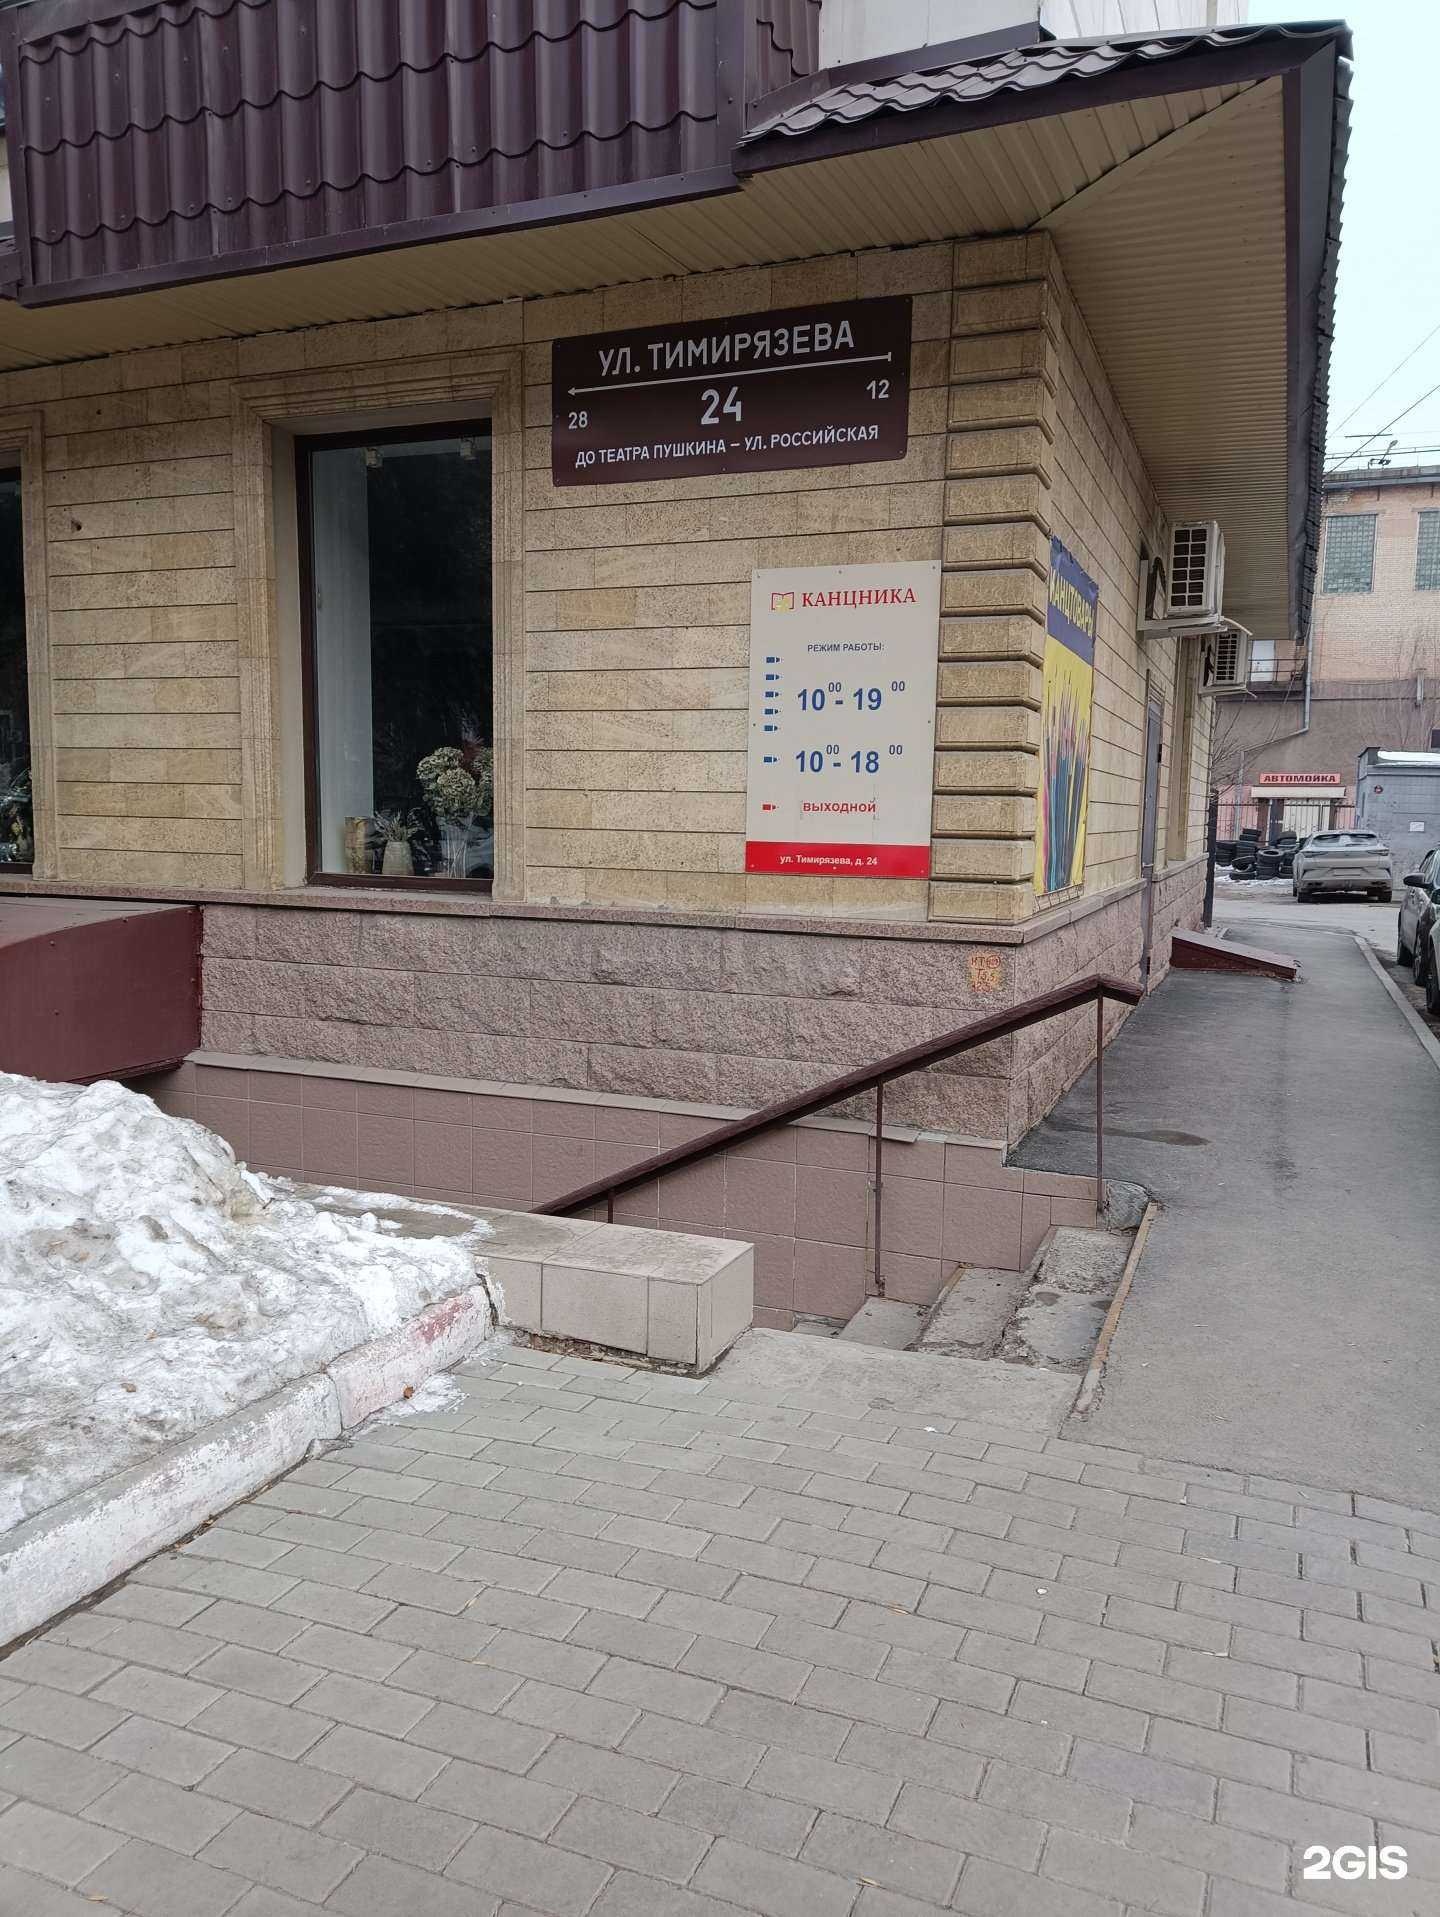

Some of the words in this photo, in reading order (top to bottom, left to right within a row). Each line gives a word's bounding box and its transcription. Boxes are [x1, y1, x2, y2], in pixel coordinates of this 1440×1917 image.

[599, 347, 641, 377] УЛ.
[648, 320, 855, 371] ТИМИРЯЗЕВА
[866, 379, 890, 400] 12
[700, 386, 743, 425] 24
[567, 411, 588, 429] 28
[575, 450, 596, 468] ДО
[598, 444, 650, 464] ТЕАТРА
[653, 438, 726, 460] ПУШКИНА
[744, 434, 768, 452] УЛ.
[771, 424, 879, 450] РОССИЙСКАЯ
[801, 587, 917, 609] КАНЦНИКА
[807, 644, 841, 653] РЕЖИМ
[843, 642, 885, 652] РАБОТЫ:
[803, 799, 877, 814] ВЫХОДНОЙ
[780, 856, 794, 865] ул.
[854, 859, 865, 867] д.
[866, 856, 878, 866] 24
